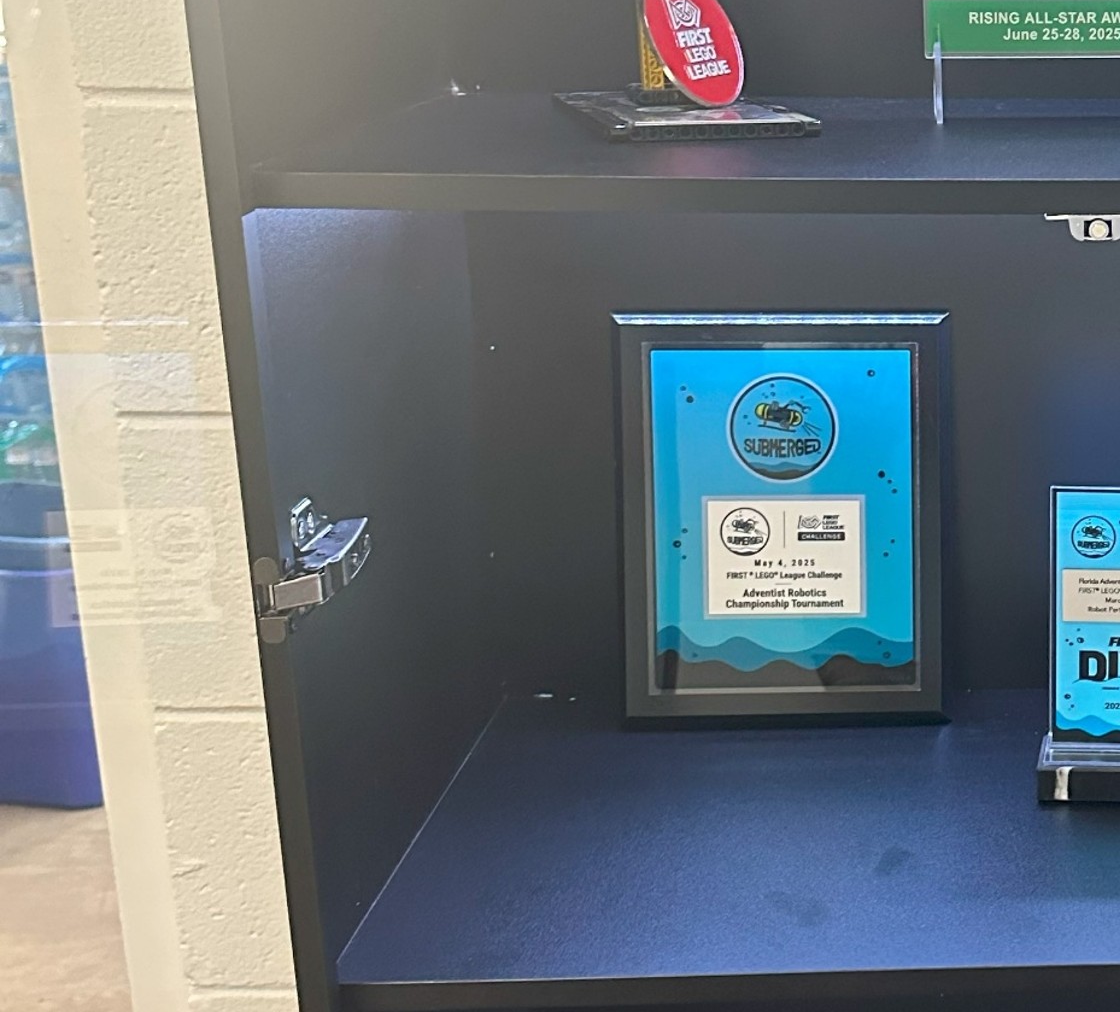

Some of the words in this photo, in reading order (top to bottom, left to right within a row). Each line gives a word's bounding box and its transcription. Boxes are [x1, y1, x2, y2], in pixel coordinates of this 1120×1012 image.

[968, 12, 1020, 24] RISING
[1024, 12, 1097, 24] ALL-STAR
[674, 28, 713, 48] FIRST
[1003, 28, 1038, 40] June
[1042, 28, 1084, 42] 25-28,
[685, 46, 716, 63] LEGO
[686, 60, 731, 80] LEAGUE
[744, 438, 821, 458] SUBMERGED
[754, 559, 773, 567] May
[778, 559, 786, 568] 4,
[780, 572, 805, 580] League
[808, 572, 842, 580] Challenge
[742, 589, 785, 598] Adventist
[788, 589, 826, 597] Robotics
[726, 600, 789, 610] Championship
[792, 600, 844, 608] Tournament
